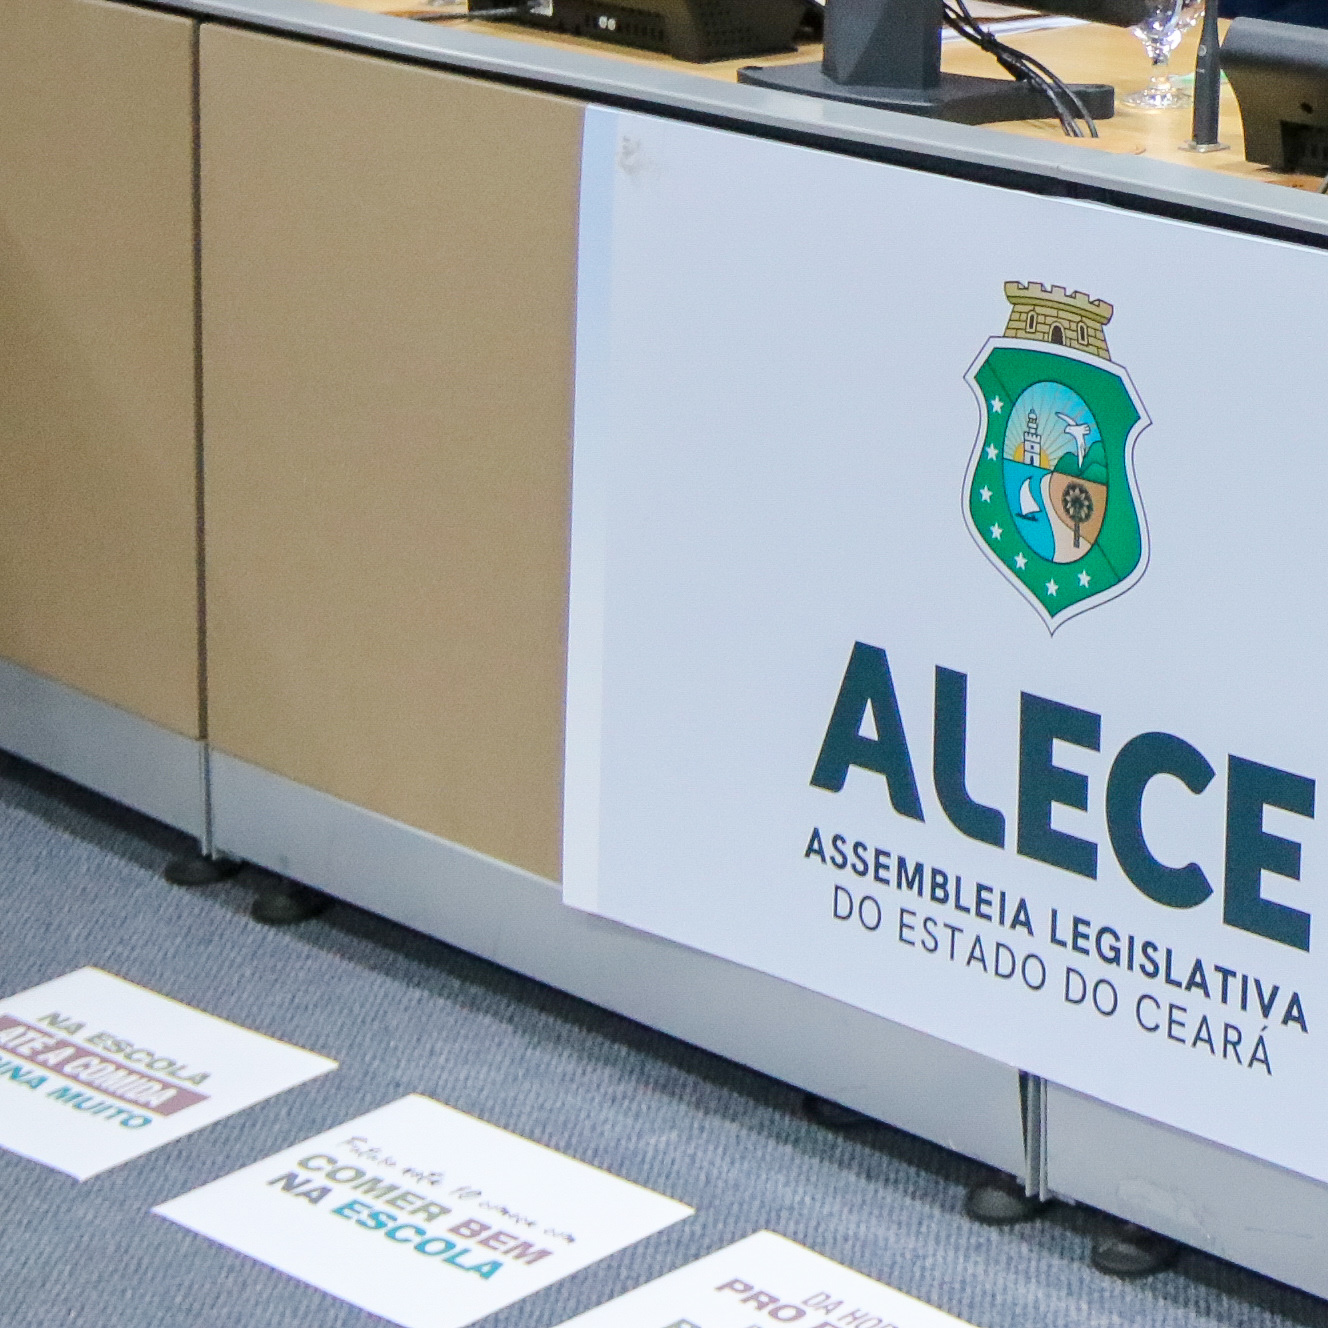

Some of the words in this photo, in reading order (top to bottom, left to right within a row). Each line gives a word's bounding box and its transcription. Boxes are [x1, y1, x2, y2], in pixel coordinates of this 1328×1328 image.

[809, 640, 1316, 953] ALECE
[804, 827, 1034, 938] ASSEMBLEIA
[1049, 908, 1310, 1034] LEGISLATIVA
[832, 885, 882, 931] DO
[898, 905, 1047, 991] ESTADO
[1064, 967, 1119, 1017] DO
[1136, 994, 1274, 1075] CEARÁ
[0, 1056, 48, 1089] INA
[46, 1085, 152, 1128] MUITO
[35, 1046, 76, 1067] A
[63, 1056, 177, 1108] COMIDA
[36, 1011, 86, 1035] NA
[84, 1030, 212, 1086] ESCOLA
[266, 1172, 332, 1205] NA
[331, 1198, 505, 1280] ESCOLA
[297, 1153, 453, 1223] COMER
[447, 1218, 554, 1266] BEM
[714, 1278, 807, 1322] PRO
[802, 1291, 844, 1315] DA
